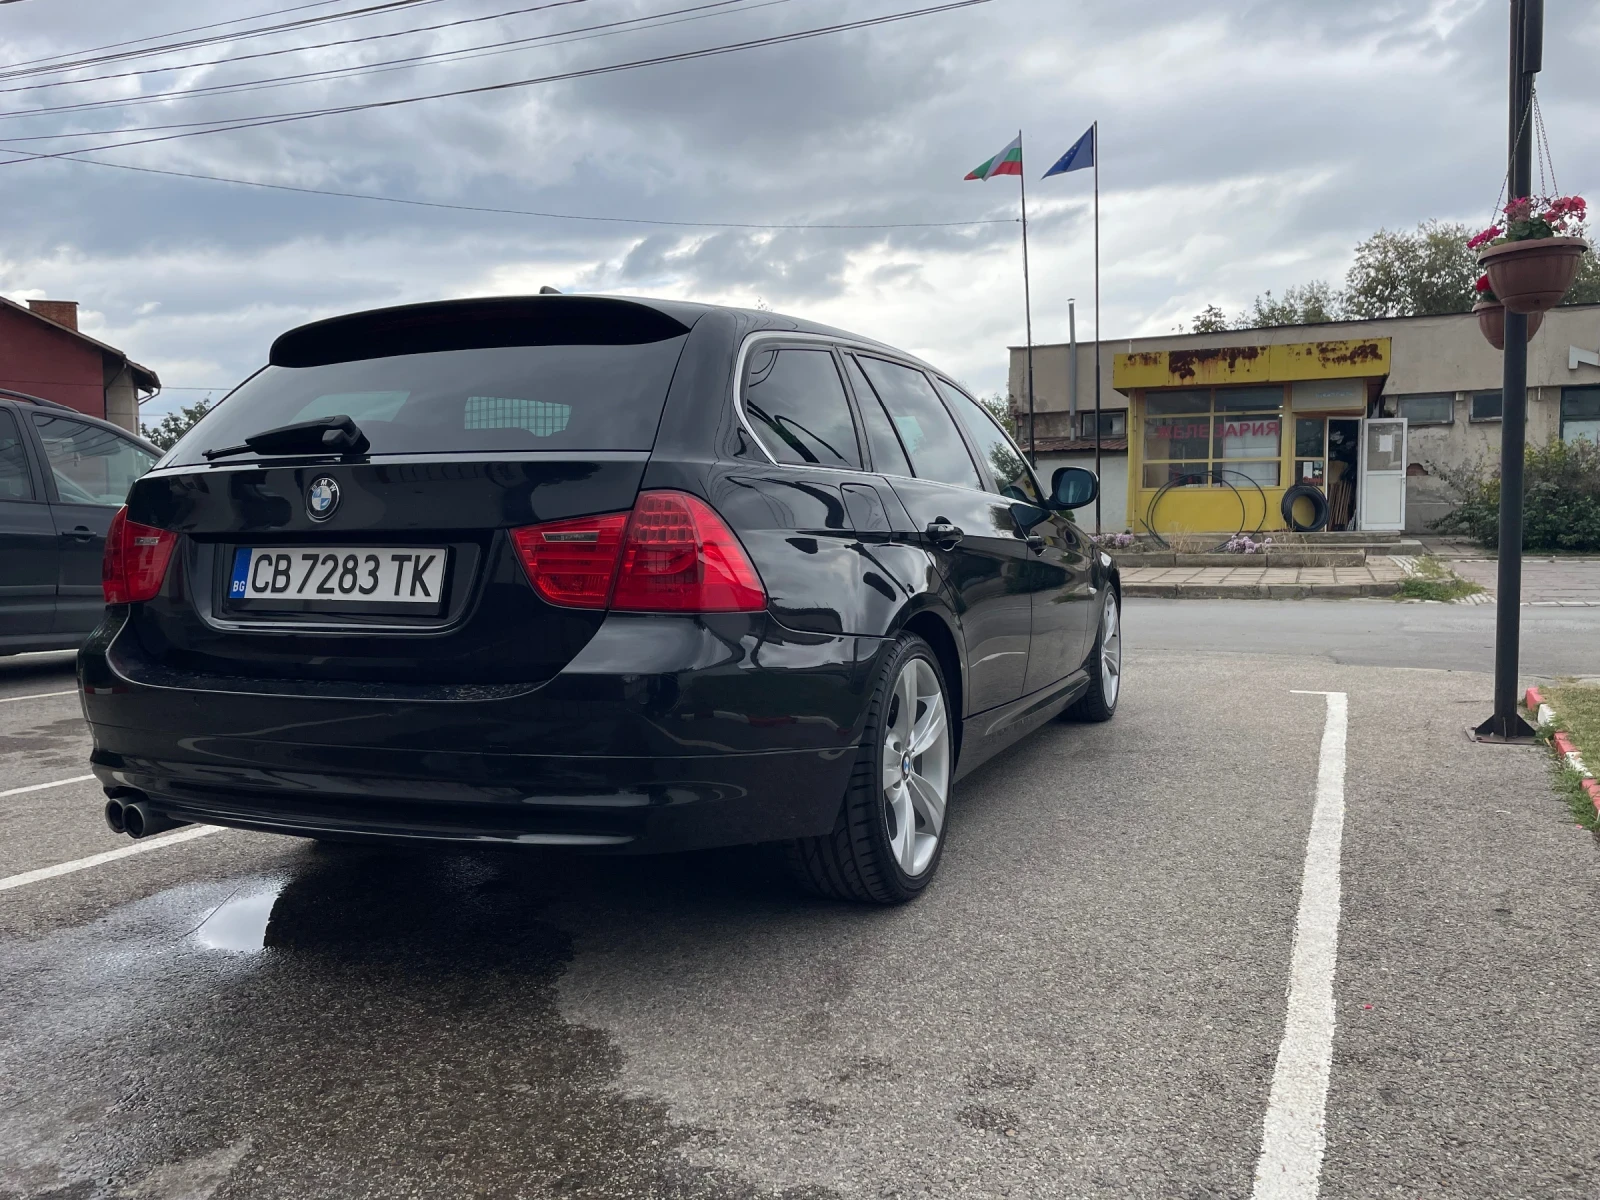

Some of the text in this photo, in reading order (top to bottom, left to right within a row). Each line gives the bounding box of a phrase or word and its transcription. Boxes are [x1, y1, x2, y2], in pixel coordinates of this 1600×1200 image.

[1156, 421, 1280, 439] ЖЕЛЕЗАРИЯ
[251, 553, 437, 597] CB 7283 TK
[232, 580, 246, 592] BG
